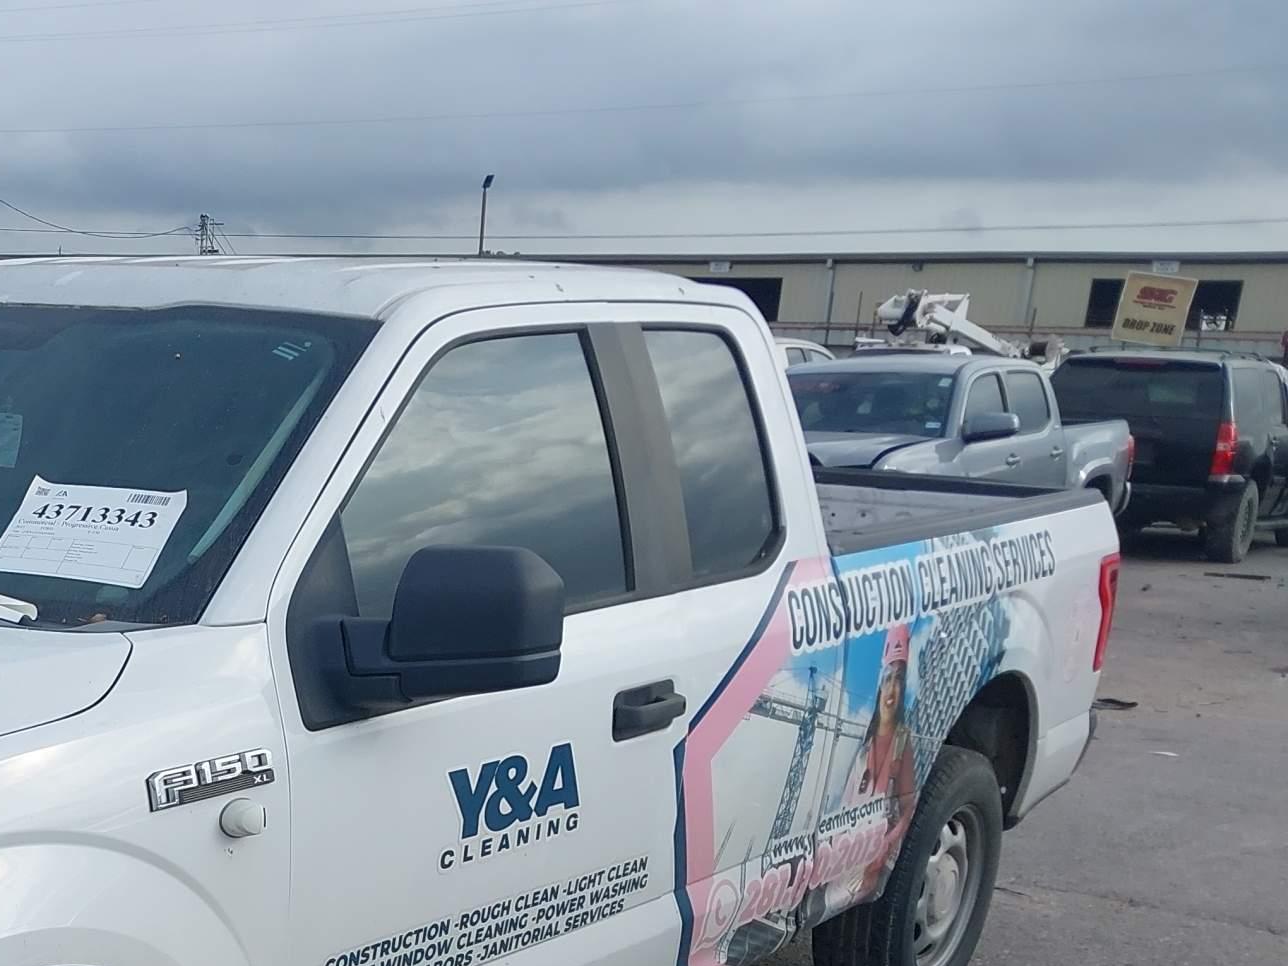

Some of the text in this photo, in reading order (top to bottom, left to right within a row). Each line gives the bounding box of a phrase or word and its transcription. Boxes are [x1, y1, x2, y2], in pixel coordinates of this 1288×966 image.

[1122, 318, 1177, 336] DROP ZONE
[32, 503, 159, 529] 43713343
[917, 541, 993, 613] CLEANING
[992, 530, 1056, 591] SERVICES
[148, 748, 272, 811] F150
[252, 773, 271, 784] XL
[448, 742, 580, 840] Y&A
[440, 812, 580, 870] CLEANING
[454, 899, 512, 931] -ROUGH
[515, 885, 560, 914] CLEAN
[562, 870, 605, 897] -LIGHT
[607, 856, 649, 882] CLEAN
[455, 913, 530, 951] CLEANING
[531, 895, 587, 926] -POWER
[588, 874, 649, 906] WASHING
[475, 922, 562, 961] -JANITORIAL
[563, 898, 626, 933] SERVICES
